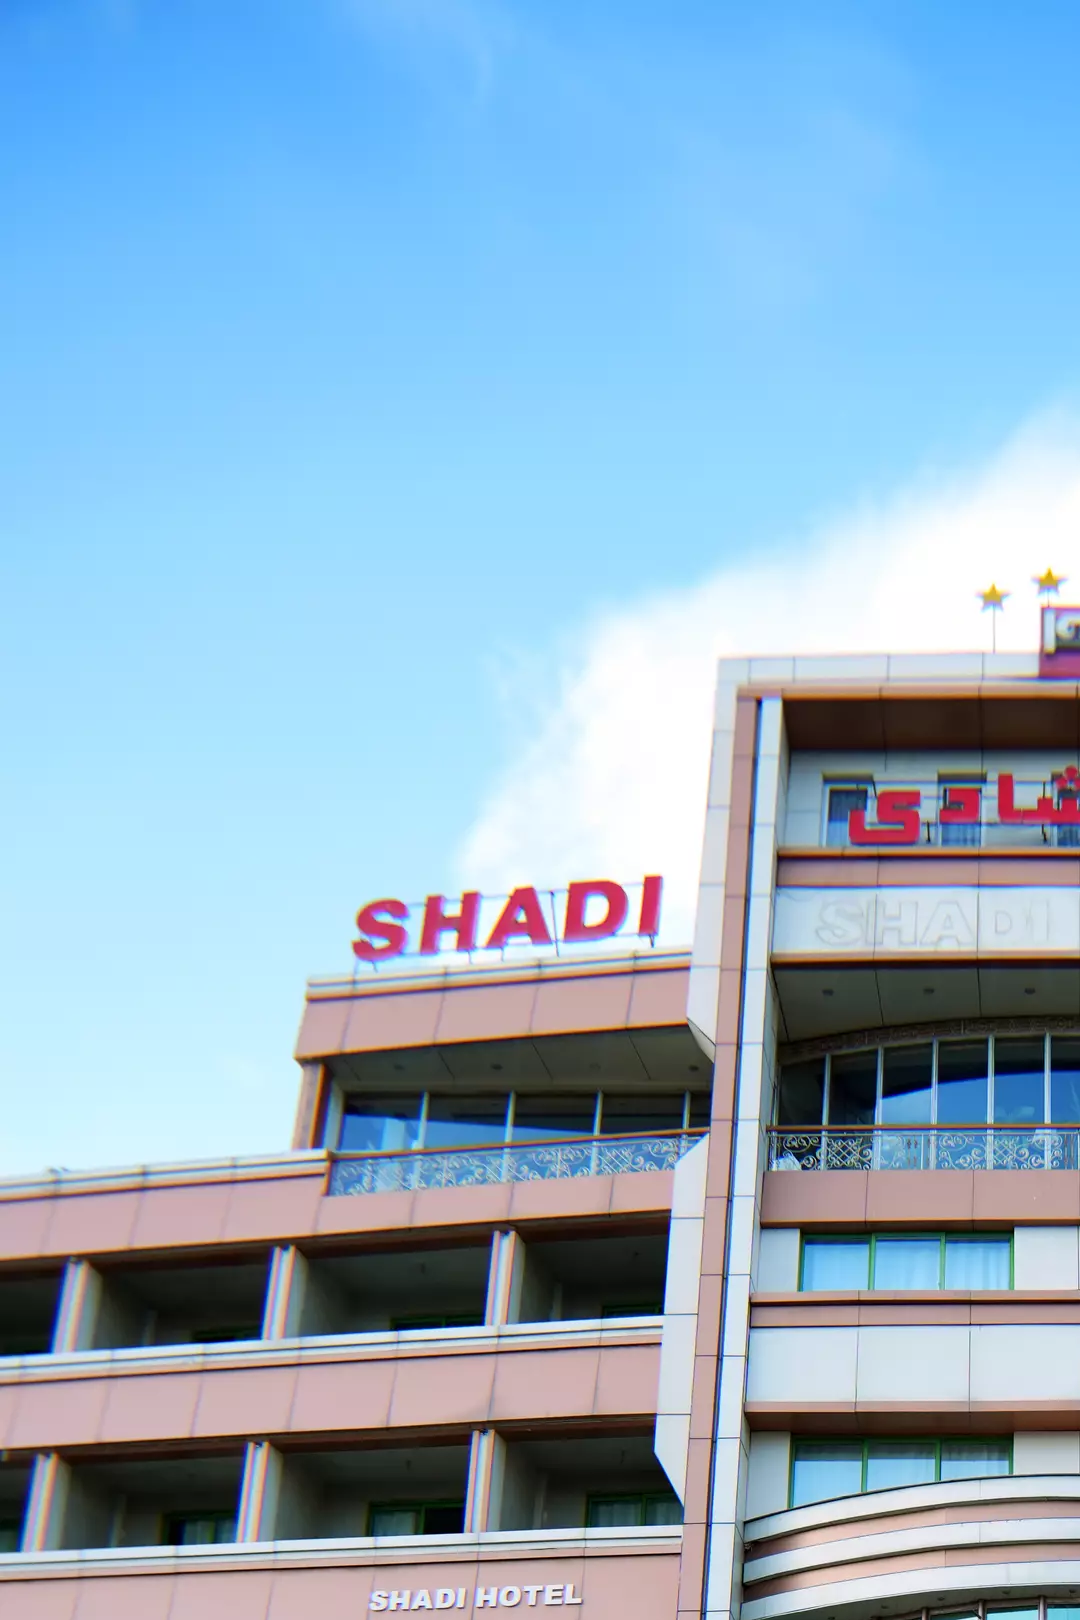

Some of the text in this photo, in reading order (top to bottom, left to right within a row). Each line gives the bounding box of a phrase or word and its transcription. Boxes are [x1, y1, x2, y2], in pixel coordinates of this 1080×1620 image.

[352, 874, 663, 961] SHADI
[815, 899, 1050, 949] SHADI
[369, 1584, 583, 1611] SHADI HOTEL
